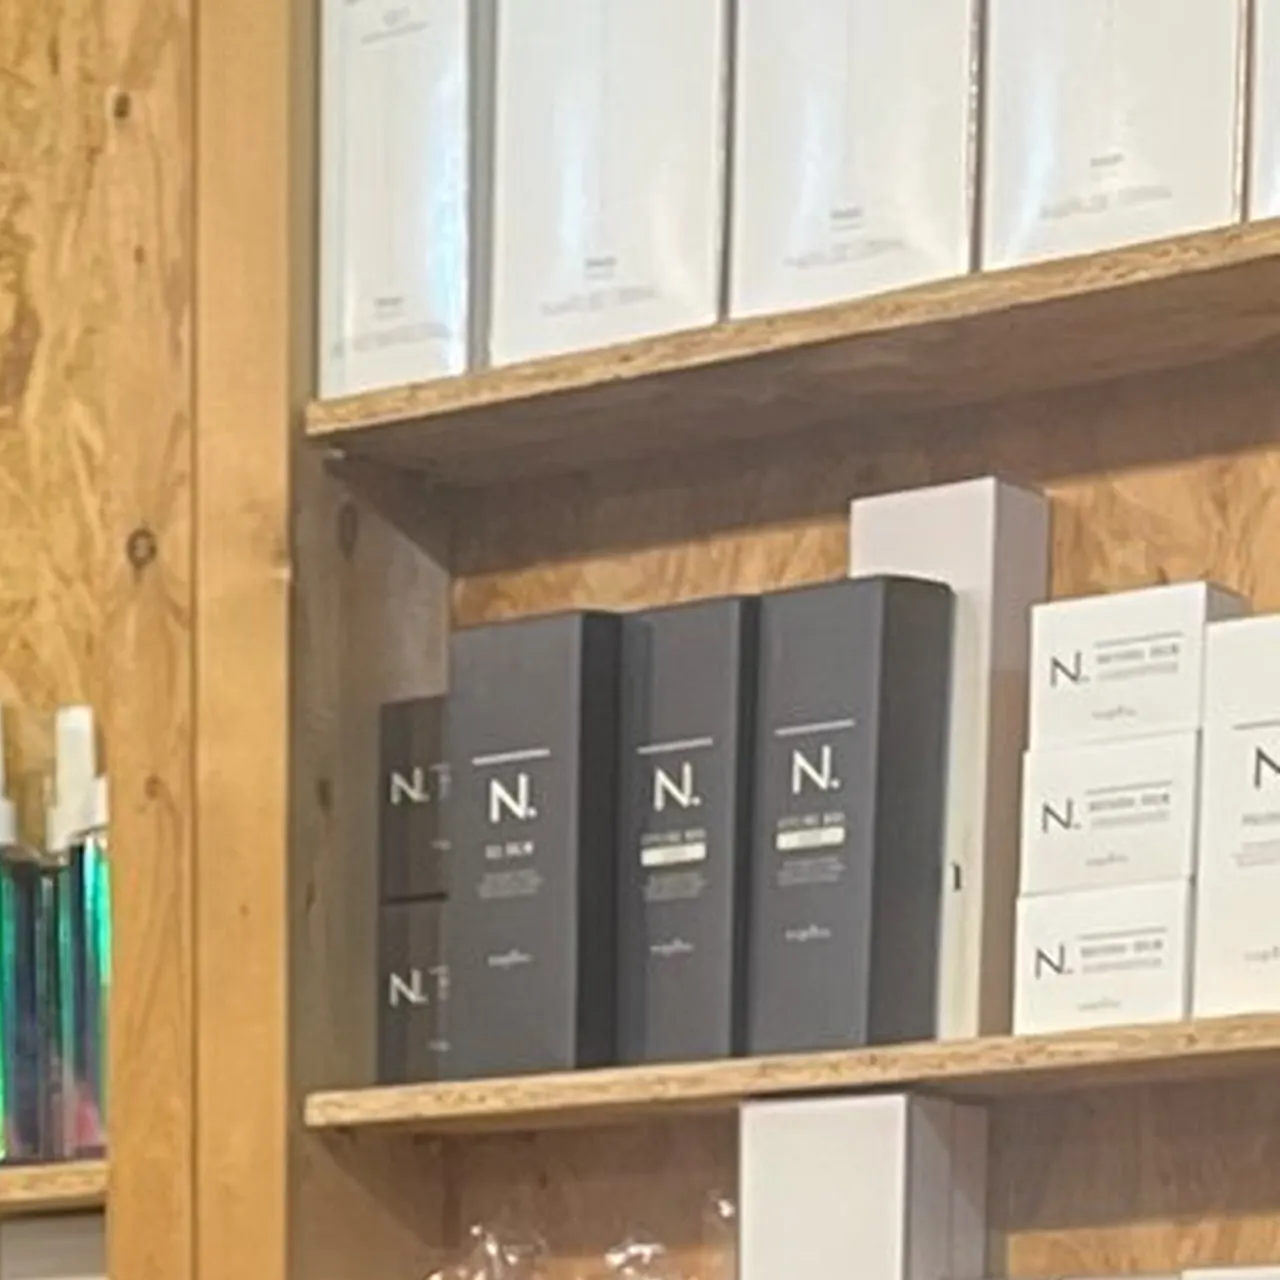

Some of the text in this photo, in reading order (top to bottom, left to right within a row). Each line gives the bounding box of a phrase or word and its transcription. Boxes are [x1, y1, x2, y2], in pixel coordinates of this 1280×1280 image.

[653, 762, 702, 812] N.
[793, 745, 840, 794] N.
[490, 773, 537, 822] N.
